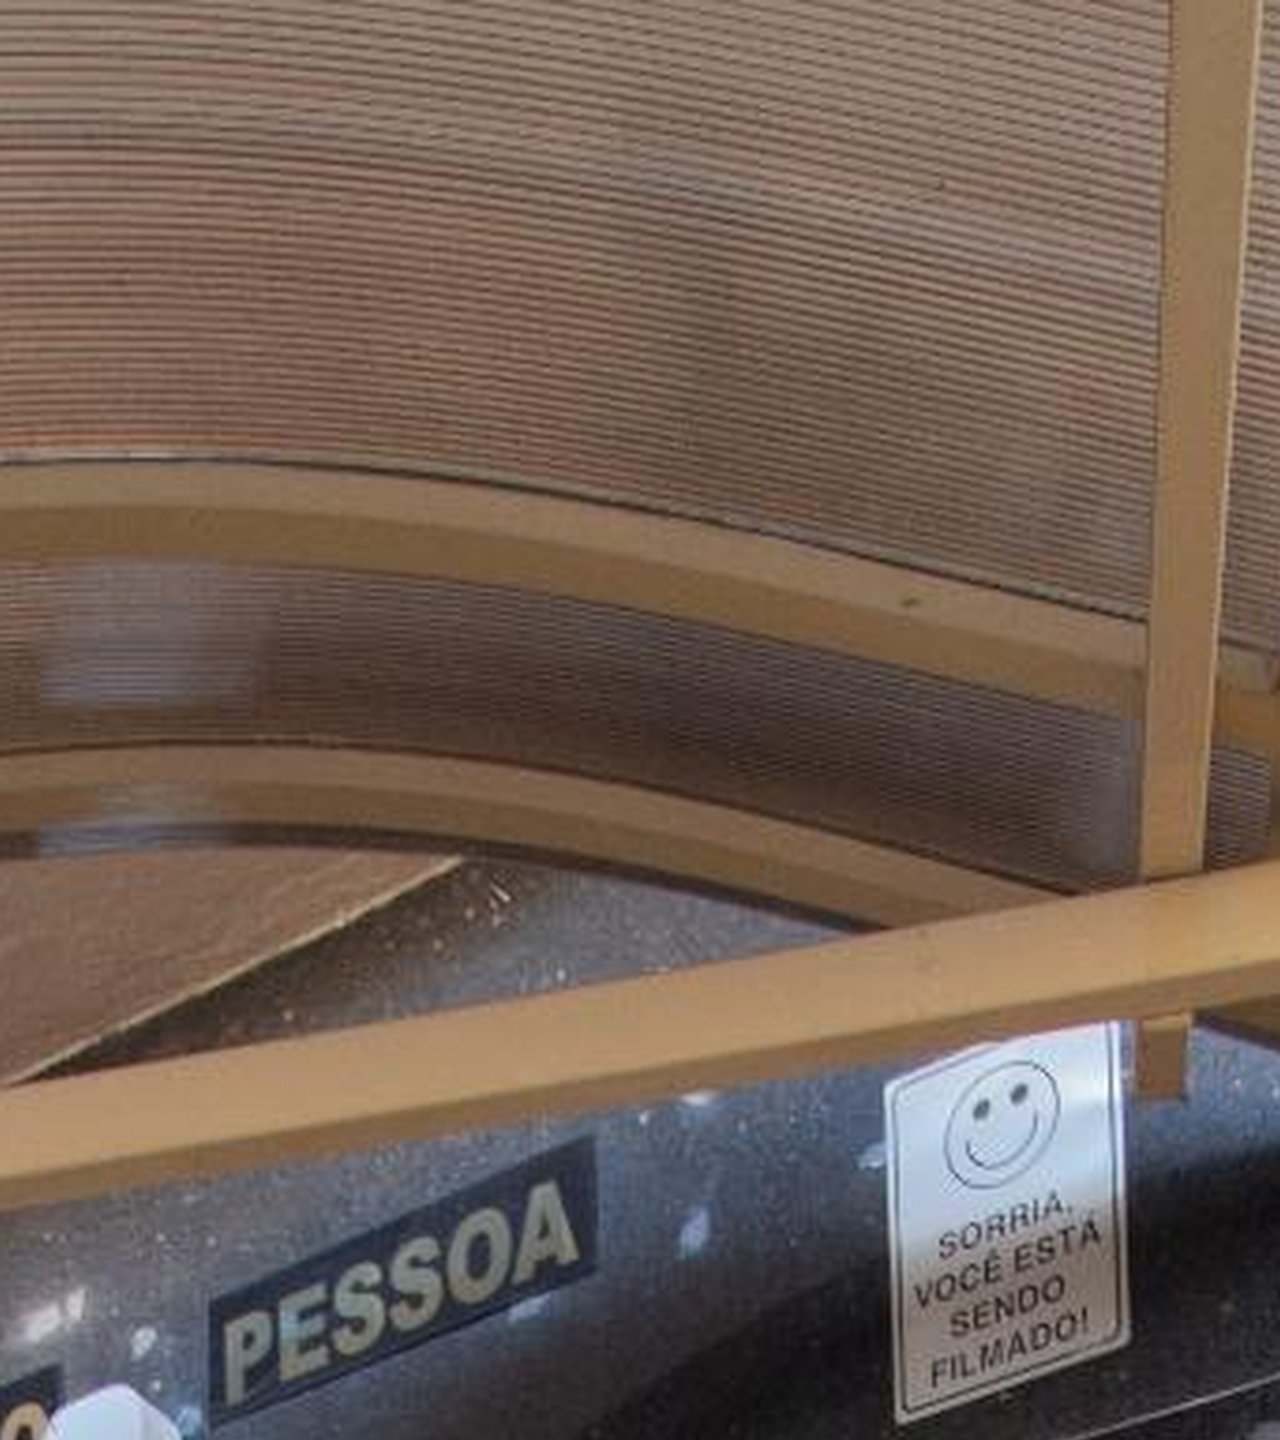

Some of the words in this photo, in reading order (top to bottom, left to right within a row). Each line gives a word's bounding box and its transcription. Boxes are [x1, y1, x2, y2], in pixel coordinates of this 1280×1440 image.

[914, 1248, 1004, 1310] VOCÊ
[1014, 1210, 1101, 1274] ESTÁ
[938, 1190, 1074, 1260] SORRIA,
[224, 1180, 581, 1406] PESSOA
[949, 1274, 1066, 1338] SENDO
[931, 1306, 1089, 1389] FILMADO!
